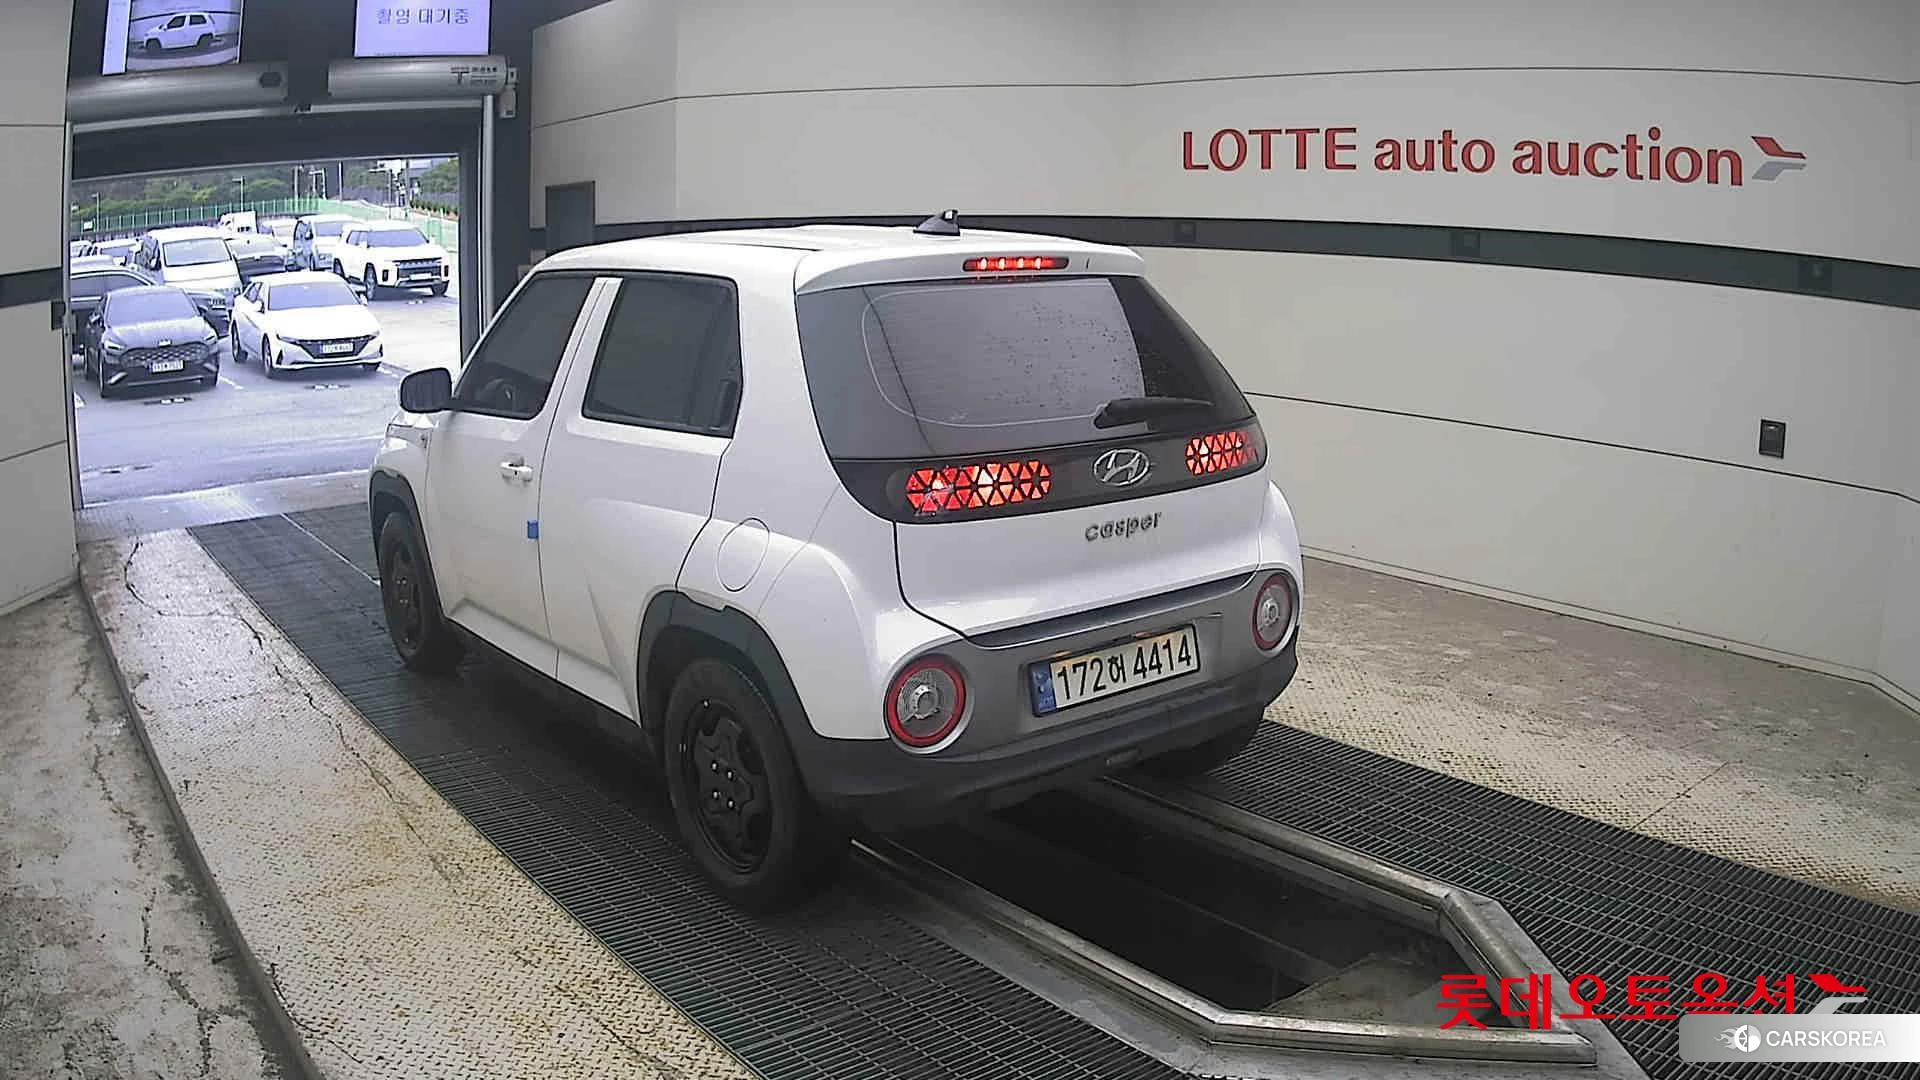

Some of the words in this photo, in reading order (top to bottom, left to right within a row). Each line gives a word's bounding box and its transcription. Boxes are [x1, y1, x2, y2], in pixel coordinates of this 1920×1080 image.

[417, 7, 470, 25] 대기중
[1182, 127, 1358, 173] LOTTE
[1373, 129, 1497, 174] auto
[1511, 127, 1744, 187] auction
[1084, 512, 1162, 543] casper
[1056, 653, 1127, 700] 172허
[1132, 634, 1192, 679] 4414
